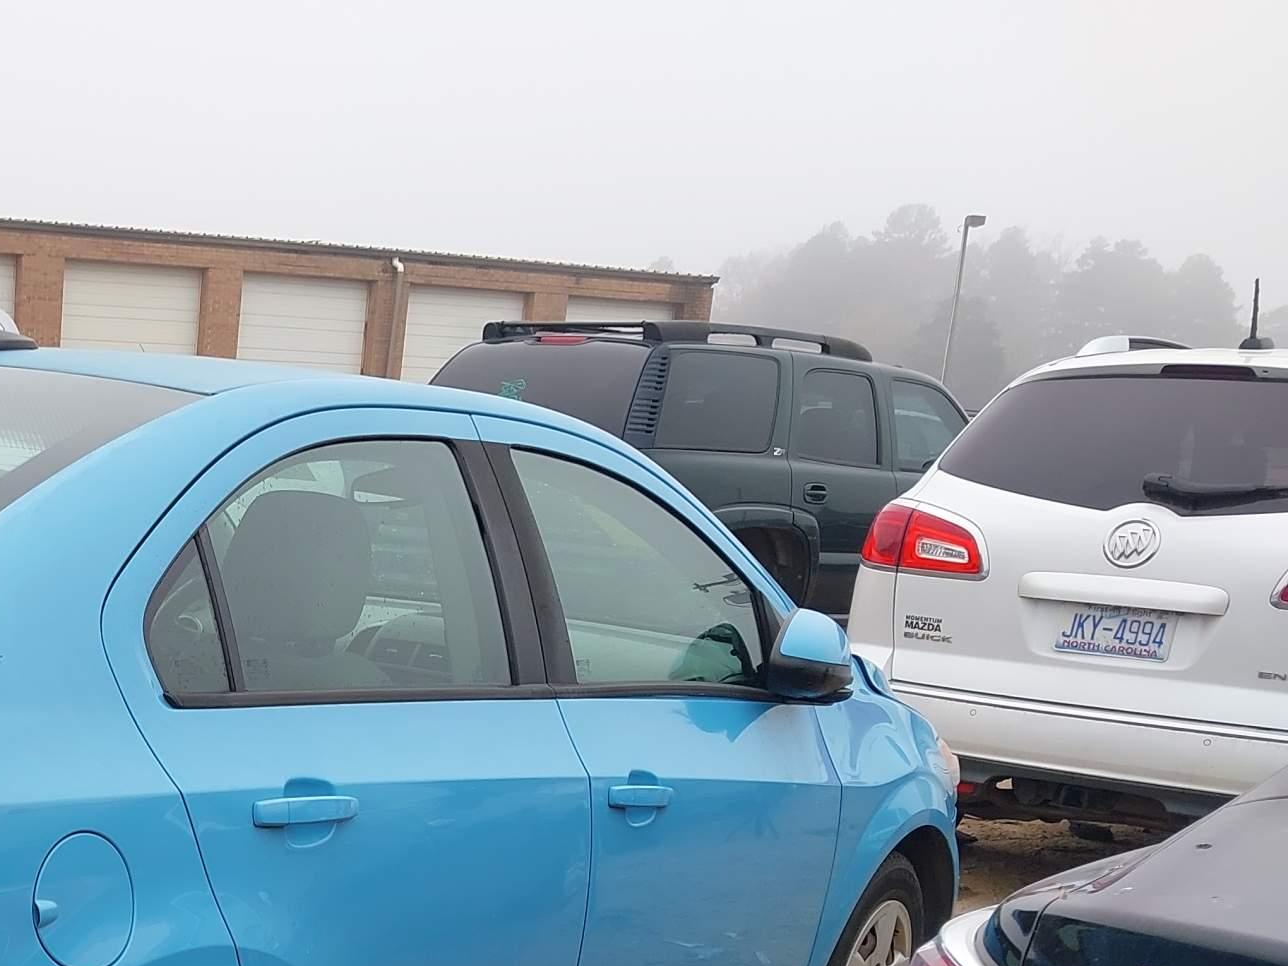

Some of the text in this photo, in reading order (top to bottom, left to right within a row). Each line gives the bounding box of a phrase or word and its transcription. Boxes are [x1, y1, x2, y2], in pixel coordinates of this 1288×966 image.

[905, 614, 943, 624] MOMENTUM
[904, 620, 942, 633] MAZDA
[1062, 613, 1167, 648] JKY-4994
[903, 631, 953, 644] BUICK
[1062, 639, 1158, 658] NORTH CAROLINA
